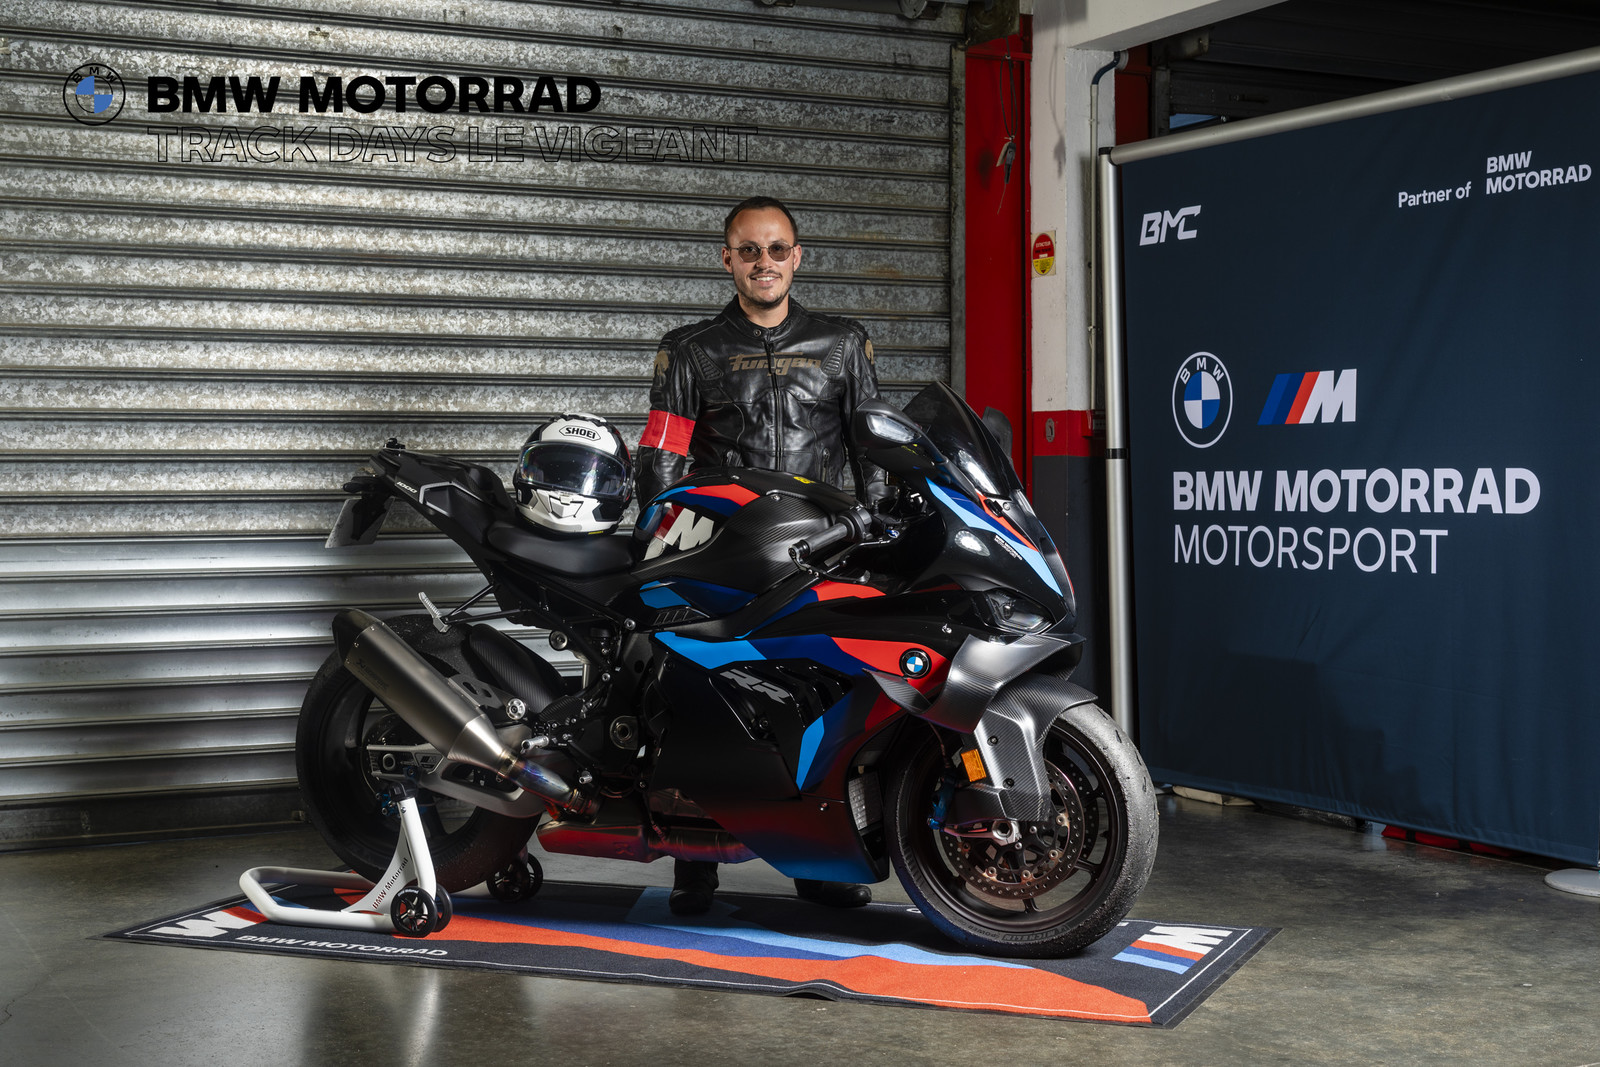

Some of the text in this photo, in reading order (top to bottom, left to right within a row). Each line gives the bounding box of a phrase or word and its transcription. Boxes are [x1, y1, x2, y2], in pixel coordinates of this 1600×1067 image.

[1485, 163, 1593, 195] MOTORRAD
[1486, 150, 1533, 174] BMW
[1398, 181, 1472, 209] Partner of
[1139, 204, 1202, 246] BMC
[1179, 356, 1225, 385] BMW
[1299, 368, 1358, 425] M
[564, 426, 597, 440] SHOEI
[1172, 466, 1542, 515] BMW MOTORRAD
[1174, 523, 1449, 575] MOTORSPORT
[719, 668, 791, 705] RR
[372, 889, 387, 910] BMW
[385, 857, 409, 891] Motorrad
[235, 935, 449, 957] BMW MOTORRAD
